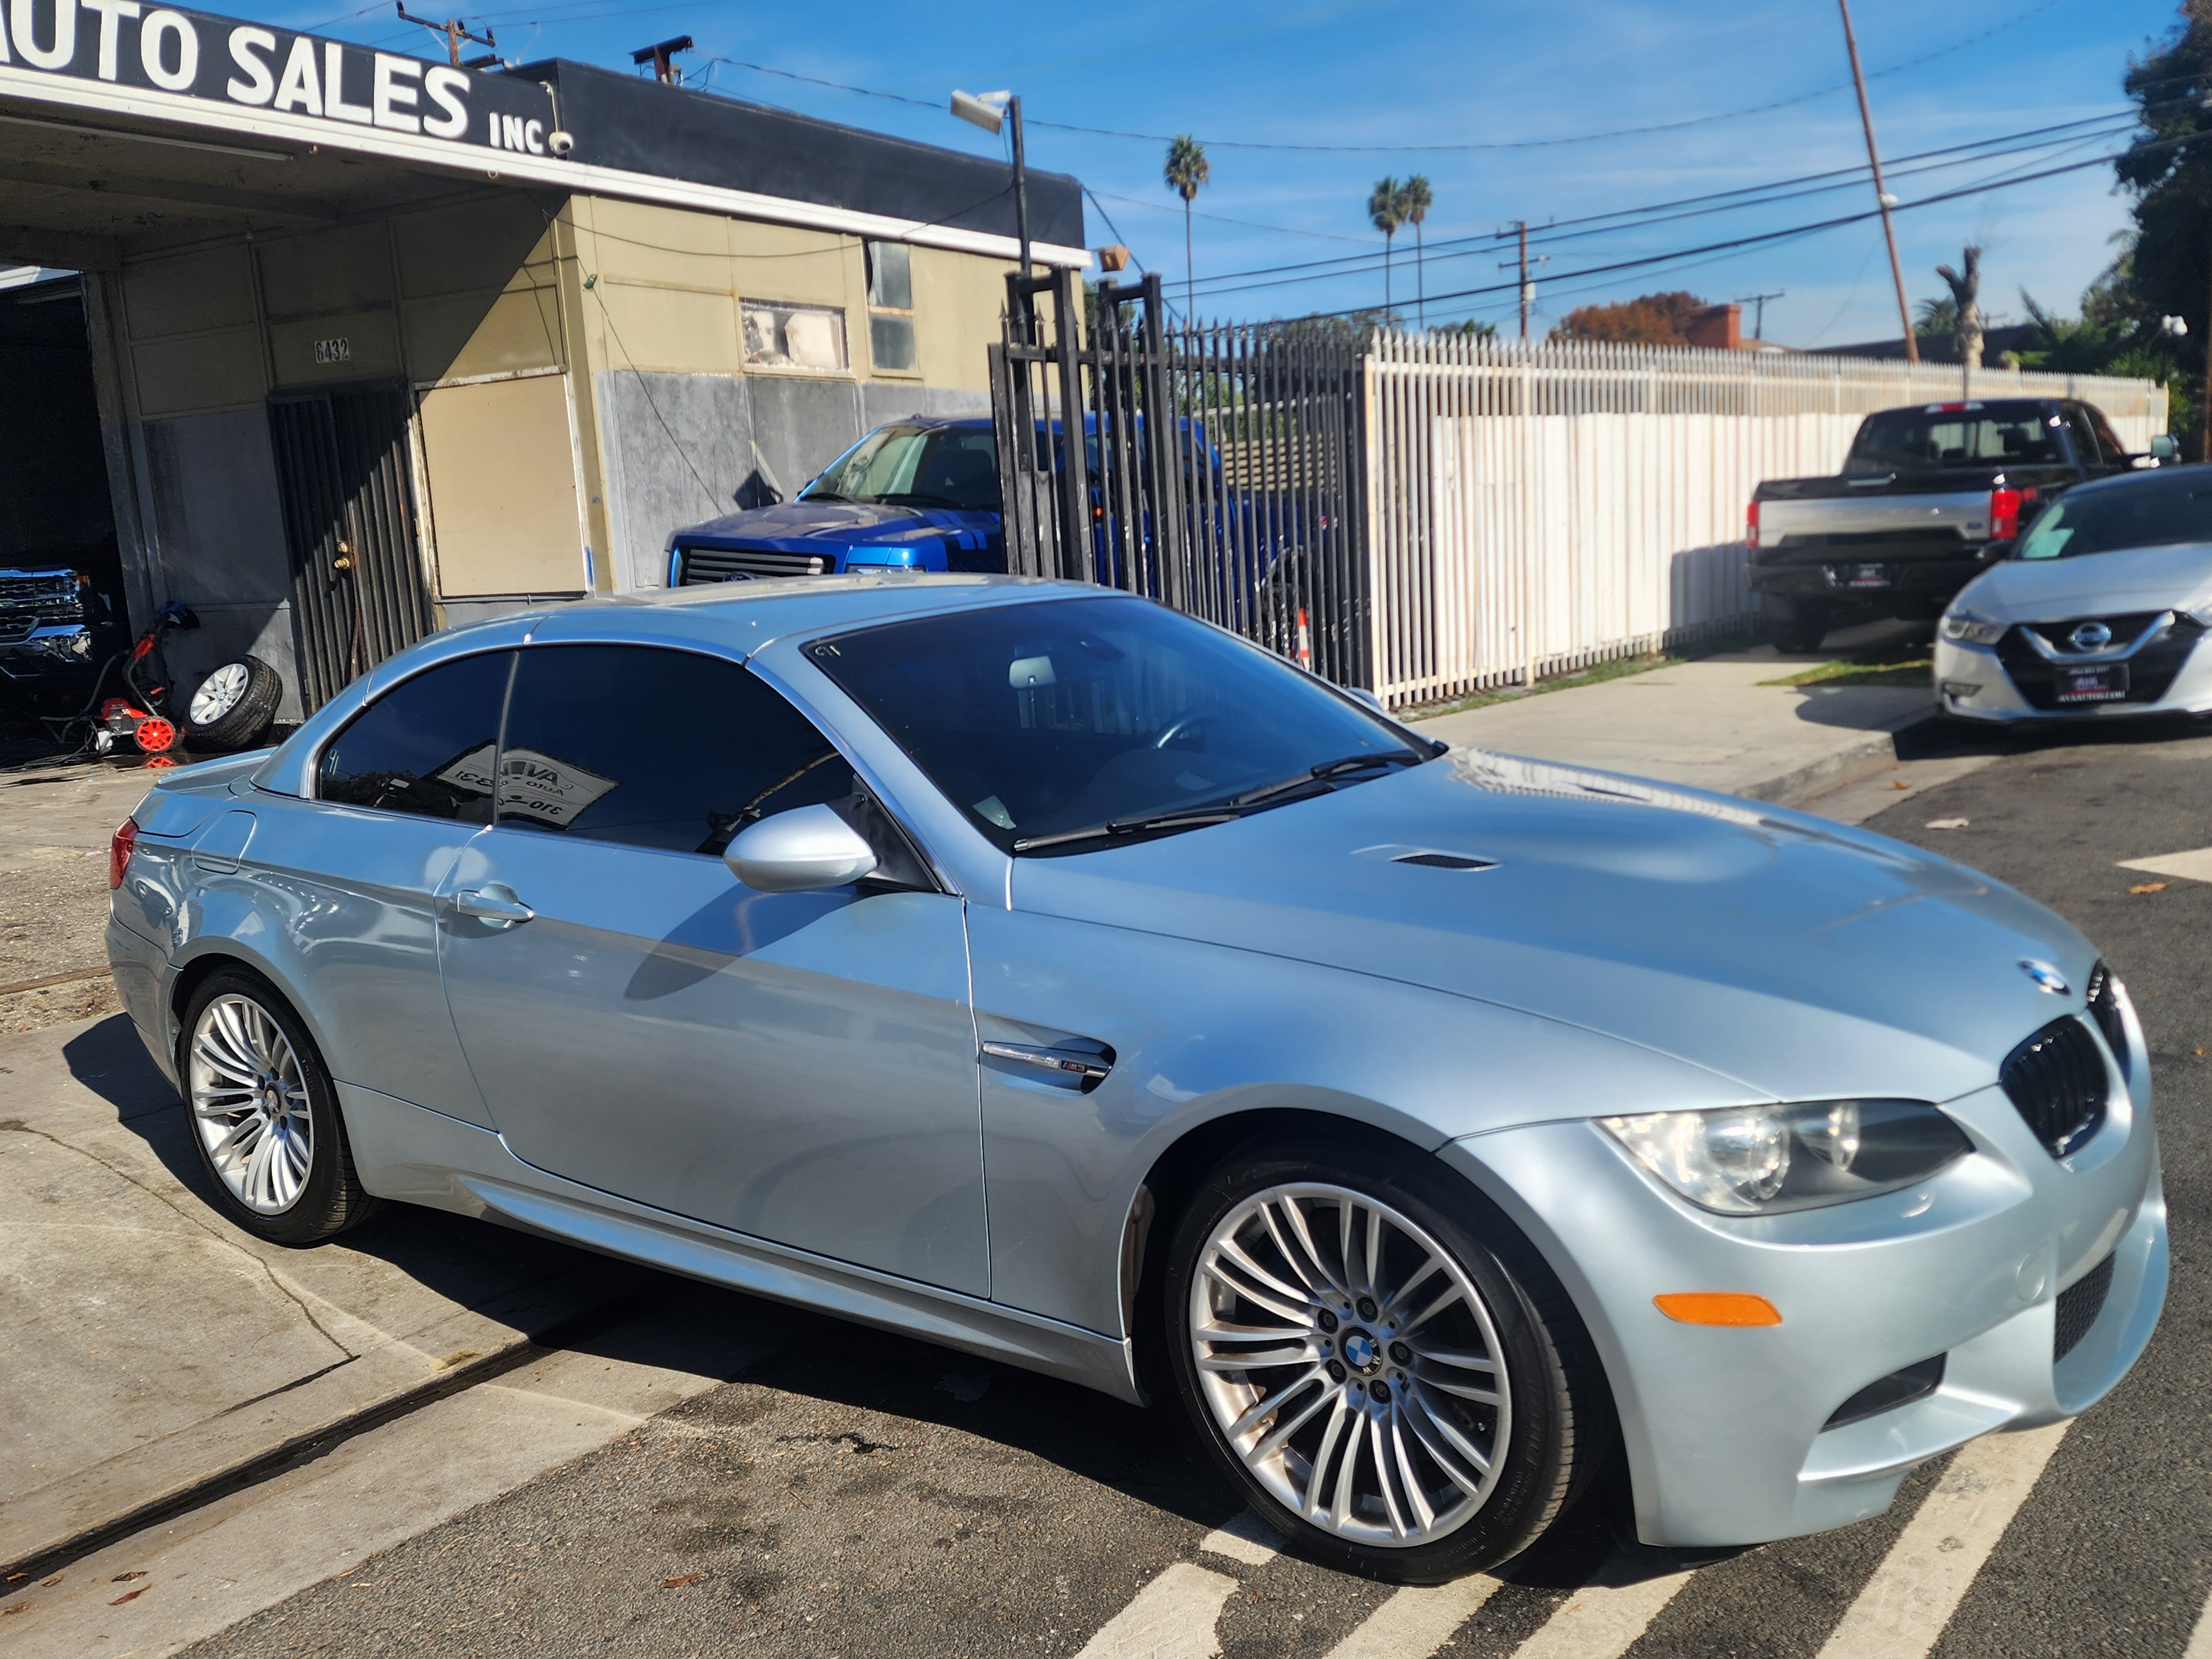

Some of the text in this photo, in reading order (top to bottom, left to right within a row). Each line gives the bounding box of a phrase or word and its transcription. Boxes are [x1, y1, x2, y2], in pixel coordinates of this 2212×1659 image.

[227, 25, 471, 139] SALES
[490, 112, 544, 154] INC
[316, 338, 349, 362] 6432
[1363, 1339, 1380, 1374] BMW
